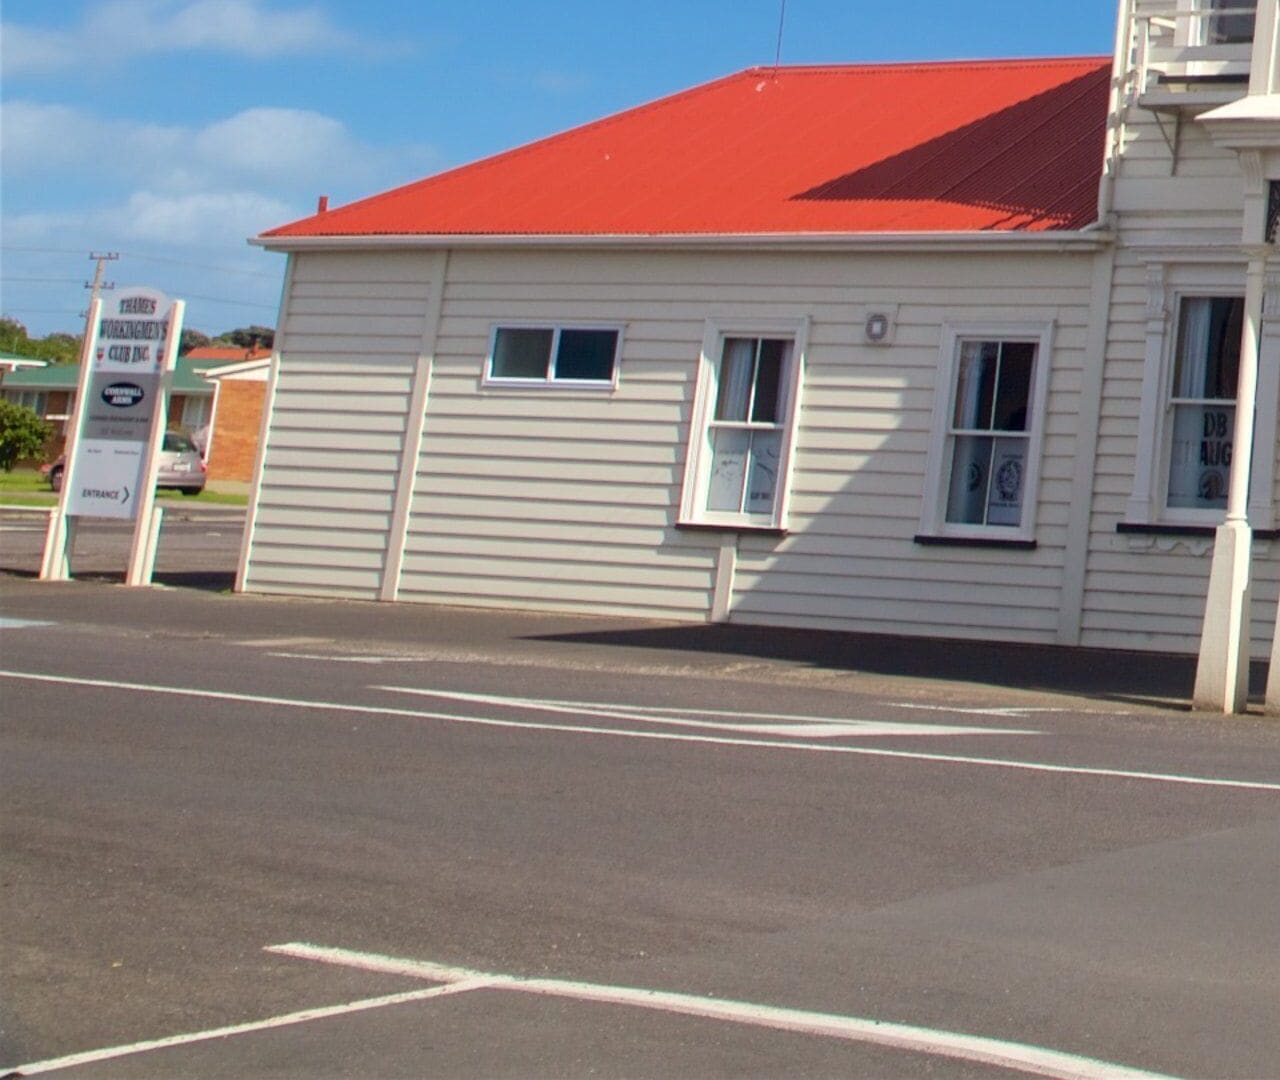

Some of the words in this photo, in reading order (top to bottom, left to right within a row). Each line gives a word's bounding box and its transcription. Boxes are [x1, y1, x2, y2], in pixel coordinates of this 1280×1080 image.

[119, 297, 157, 315] THAMES
[1204, 411, 1227, 438] DB
[82, 488, 119, 501] ENTRANCE
